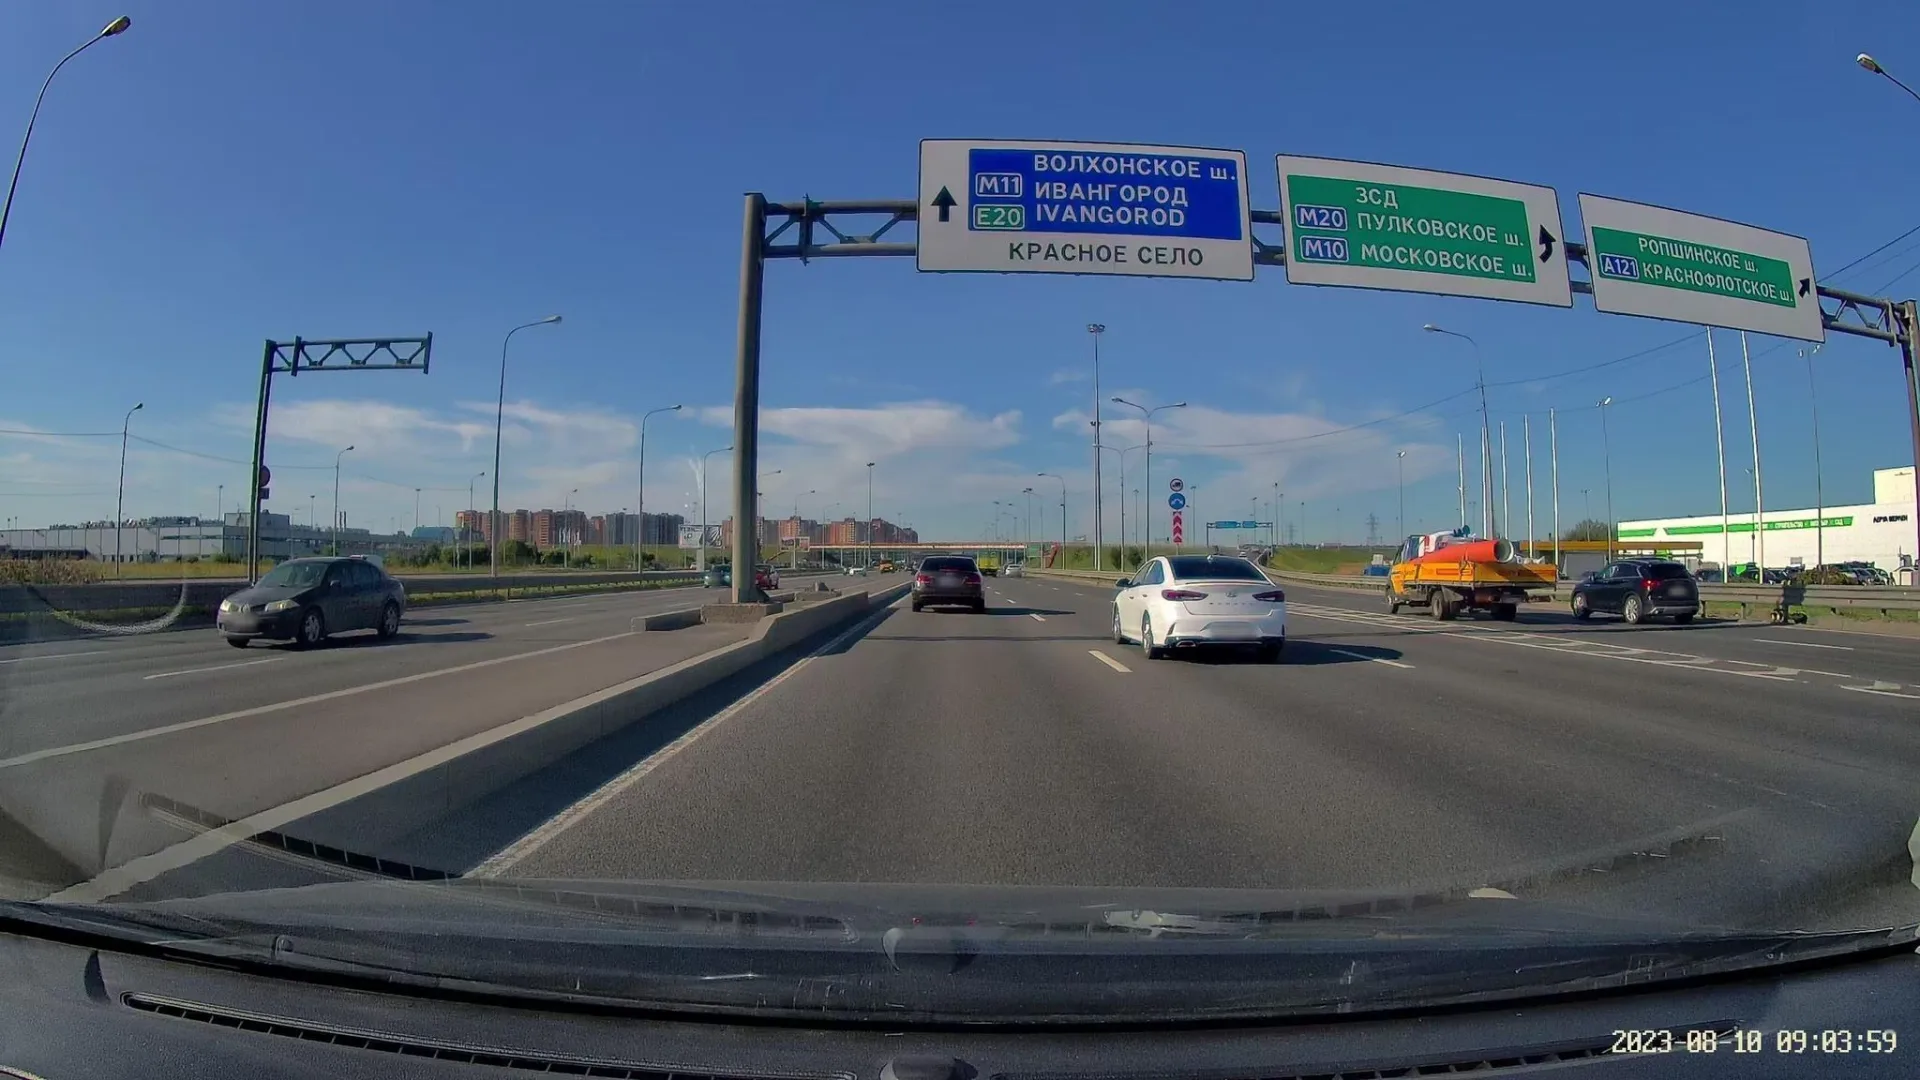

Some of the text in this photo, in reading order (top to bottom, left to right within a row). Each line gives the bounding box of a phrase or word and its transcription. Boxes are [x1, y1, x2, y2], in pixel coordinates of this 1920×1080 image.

[1034, 154, 1236, 180] ВОЛХОНСКОЕ ш.
[979, 176, 1020, 194] М11
[1035, 182, 1188, 206] ИВАНГОРОД
[1356, 187, 1398, 209] ЗСД
[977, 208, 1021, 226] E20
[1036, 204, 1185, 226] IVANGOROD
[1300, 208, 1343, 226] М20
[1357, 213, 1524, 246] ПУЛКОВСКОЕ ш.
[1009, 243, 1203, 265] КРАСНОЕ СЕЛО
[1305, 240, 1345, 259] М10
[1361, 243, 1532, 277] МОСКОВСКОЕ ш.
[1638, 237, 1759, 272] РОПШИНСКОЕ ш.
[1643, 263, 1793, 302] КРАСНОФЛОТСКОЕ ш.
